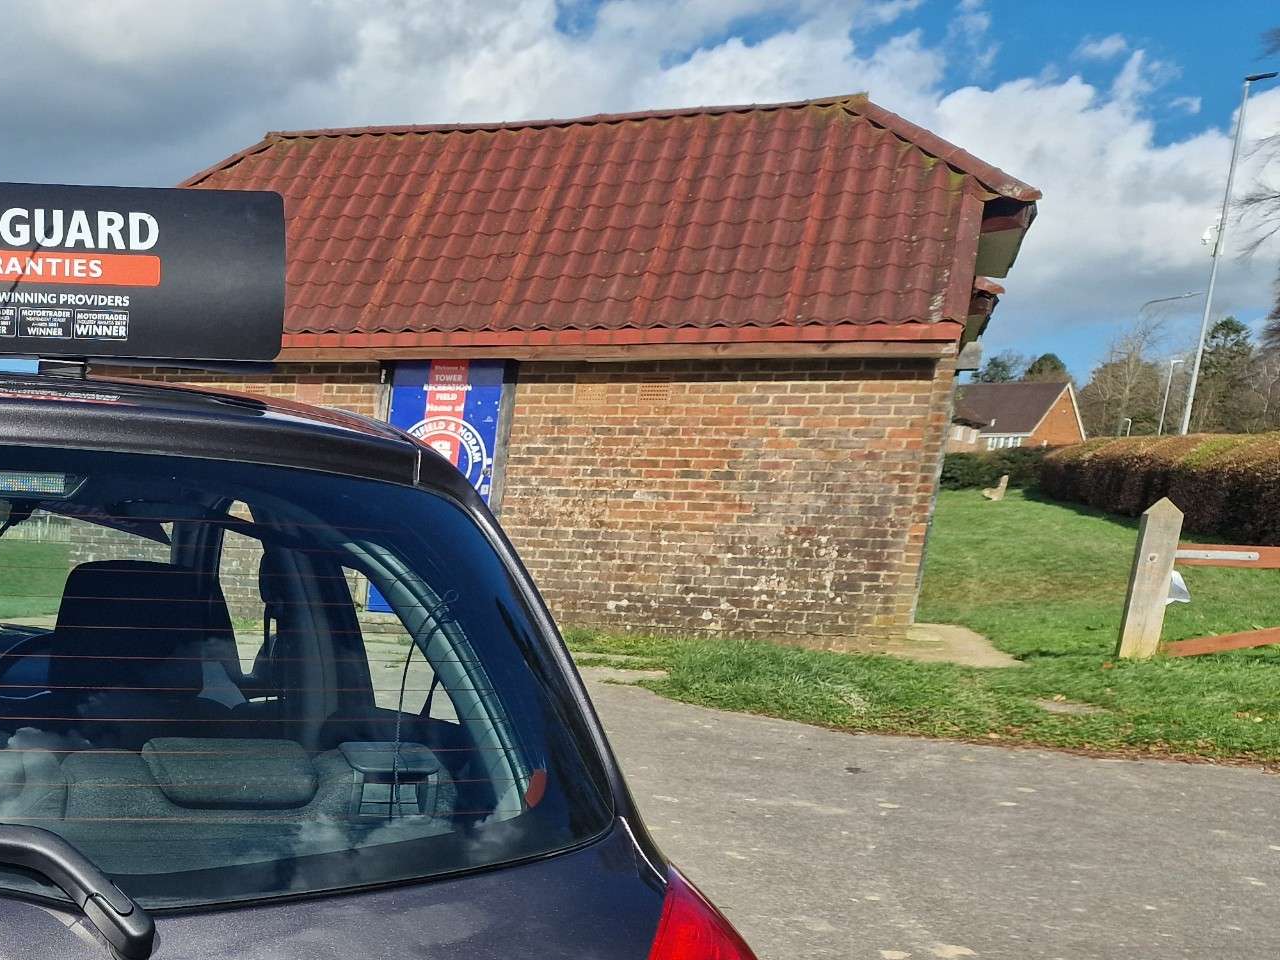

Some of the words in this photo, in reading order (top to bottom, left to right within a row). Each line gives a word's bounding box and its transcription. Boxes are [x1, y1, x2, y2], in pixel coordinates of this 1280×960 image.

[59, 293, 130, 307] PROVIDERS
[21, 309, 71, 318] MOTORTRADER
[77, 312, 127, 321] MOTORTRADER
[27, 327, 63, 336] WINNER
[75, 325, 127, 337] WINNER
[434, 374, 463, 382] TOWER
